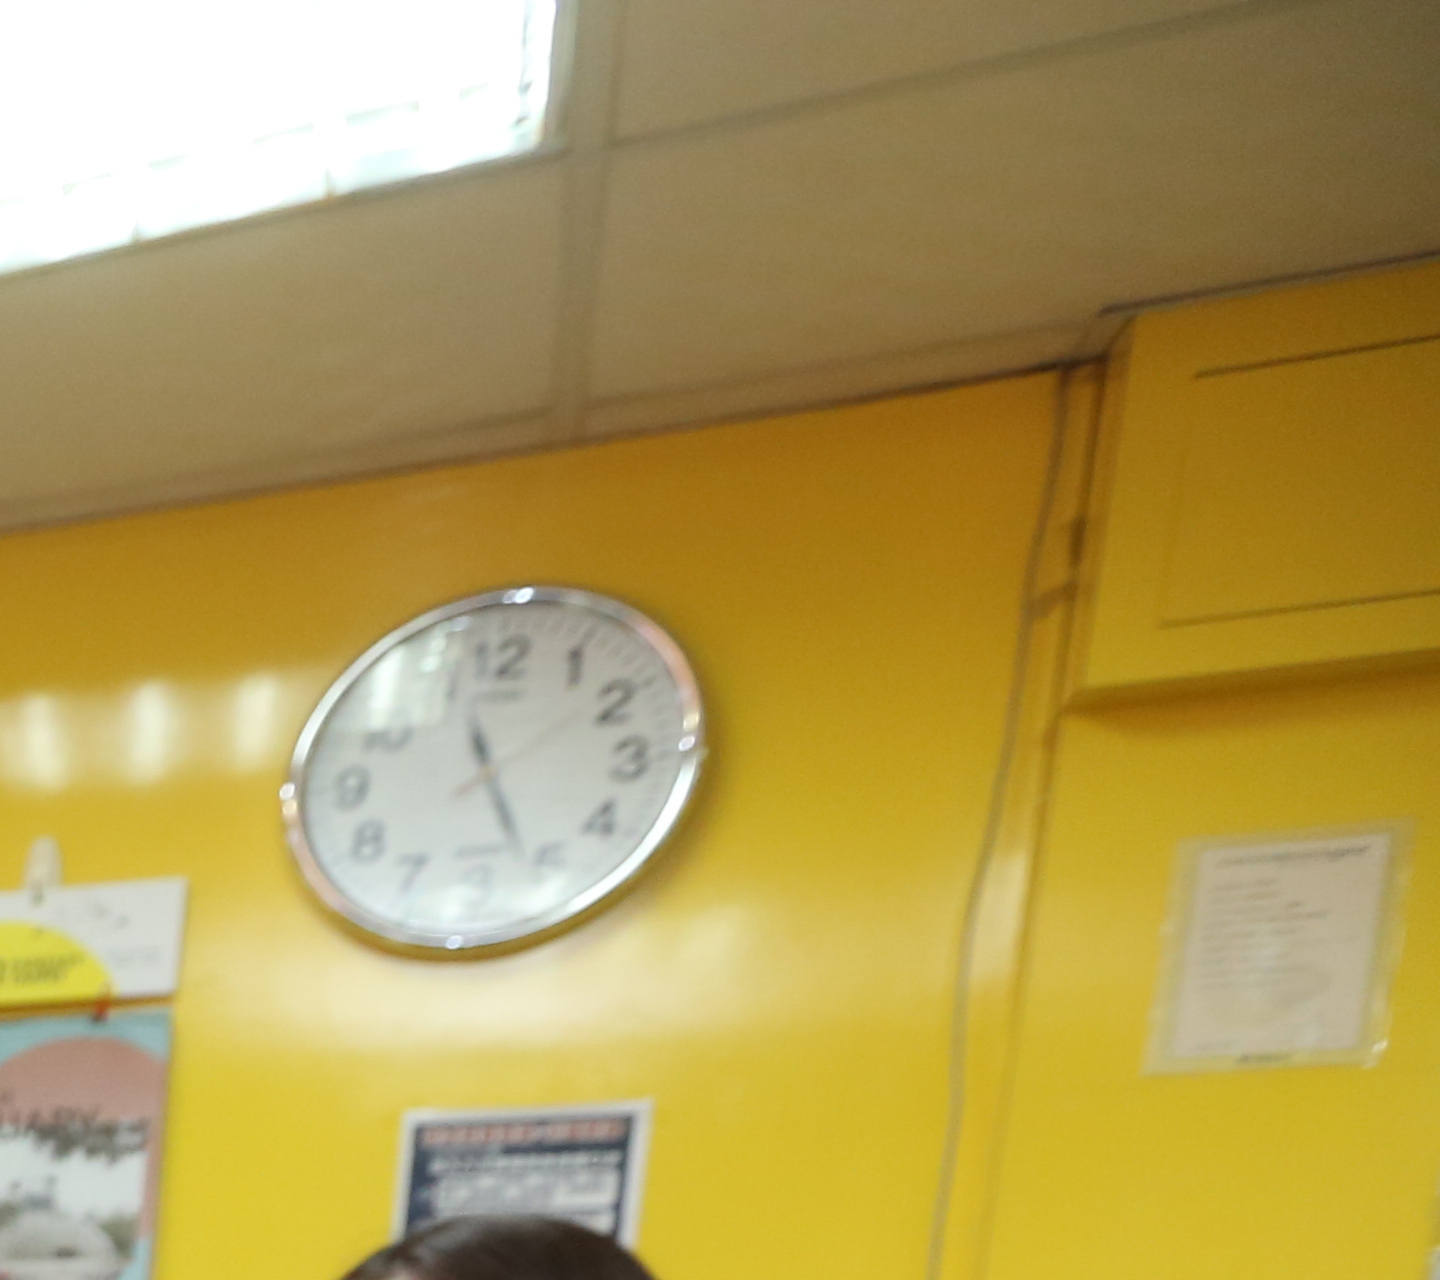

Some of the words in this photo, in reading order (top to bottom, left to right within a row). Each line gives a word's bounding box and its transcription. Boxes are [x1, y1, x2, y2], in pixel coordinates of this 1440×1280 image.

[473, 636, 531, 681] 12
[565, 650, 583, 687] 1
[597, 679, 637, 725] 2
[612, 737, 649, 783] 3
[334, 765, 372, 810] 9
[351, 821, 386, 861] 8
[583, 799, 623, 838] 4
